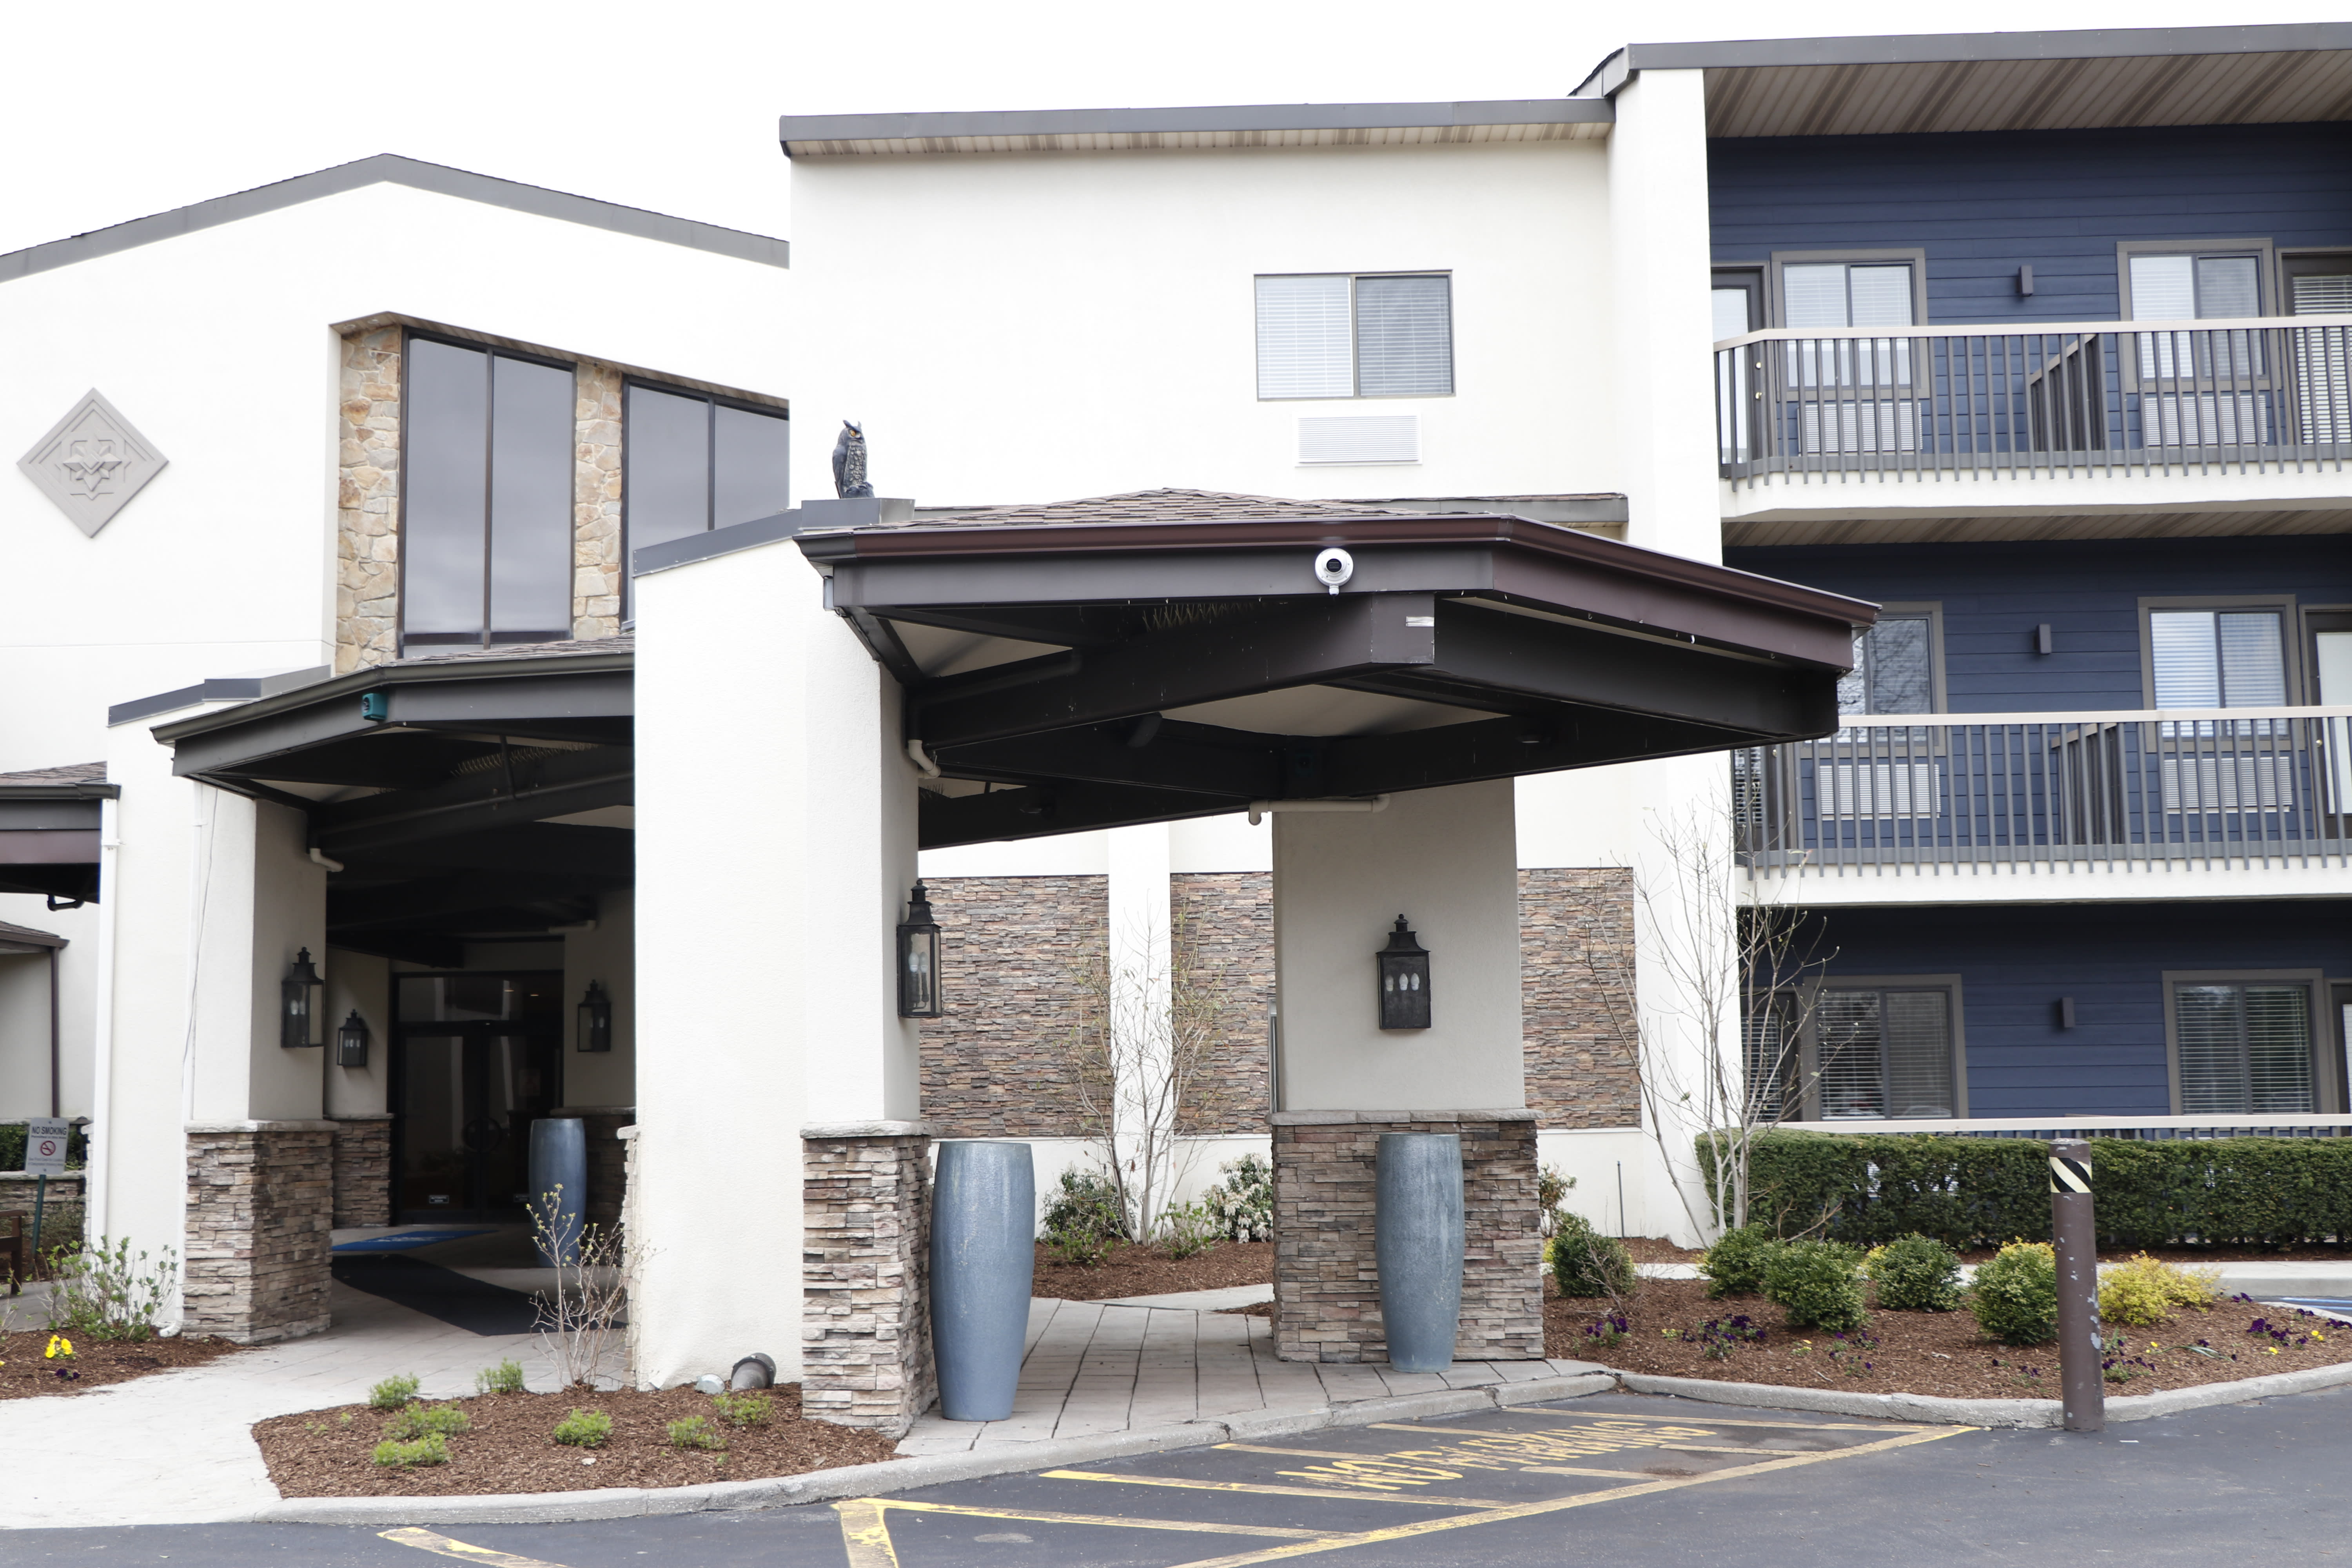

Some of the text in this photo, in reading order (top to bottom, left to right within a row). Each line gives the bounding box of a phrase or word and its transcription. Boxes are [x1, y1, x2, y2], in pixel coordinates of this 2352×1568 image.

[42, 1127, 67, 1135] SMOKING
[1275, 1421, 1717, 1490] NO PARKING
